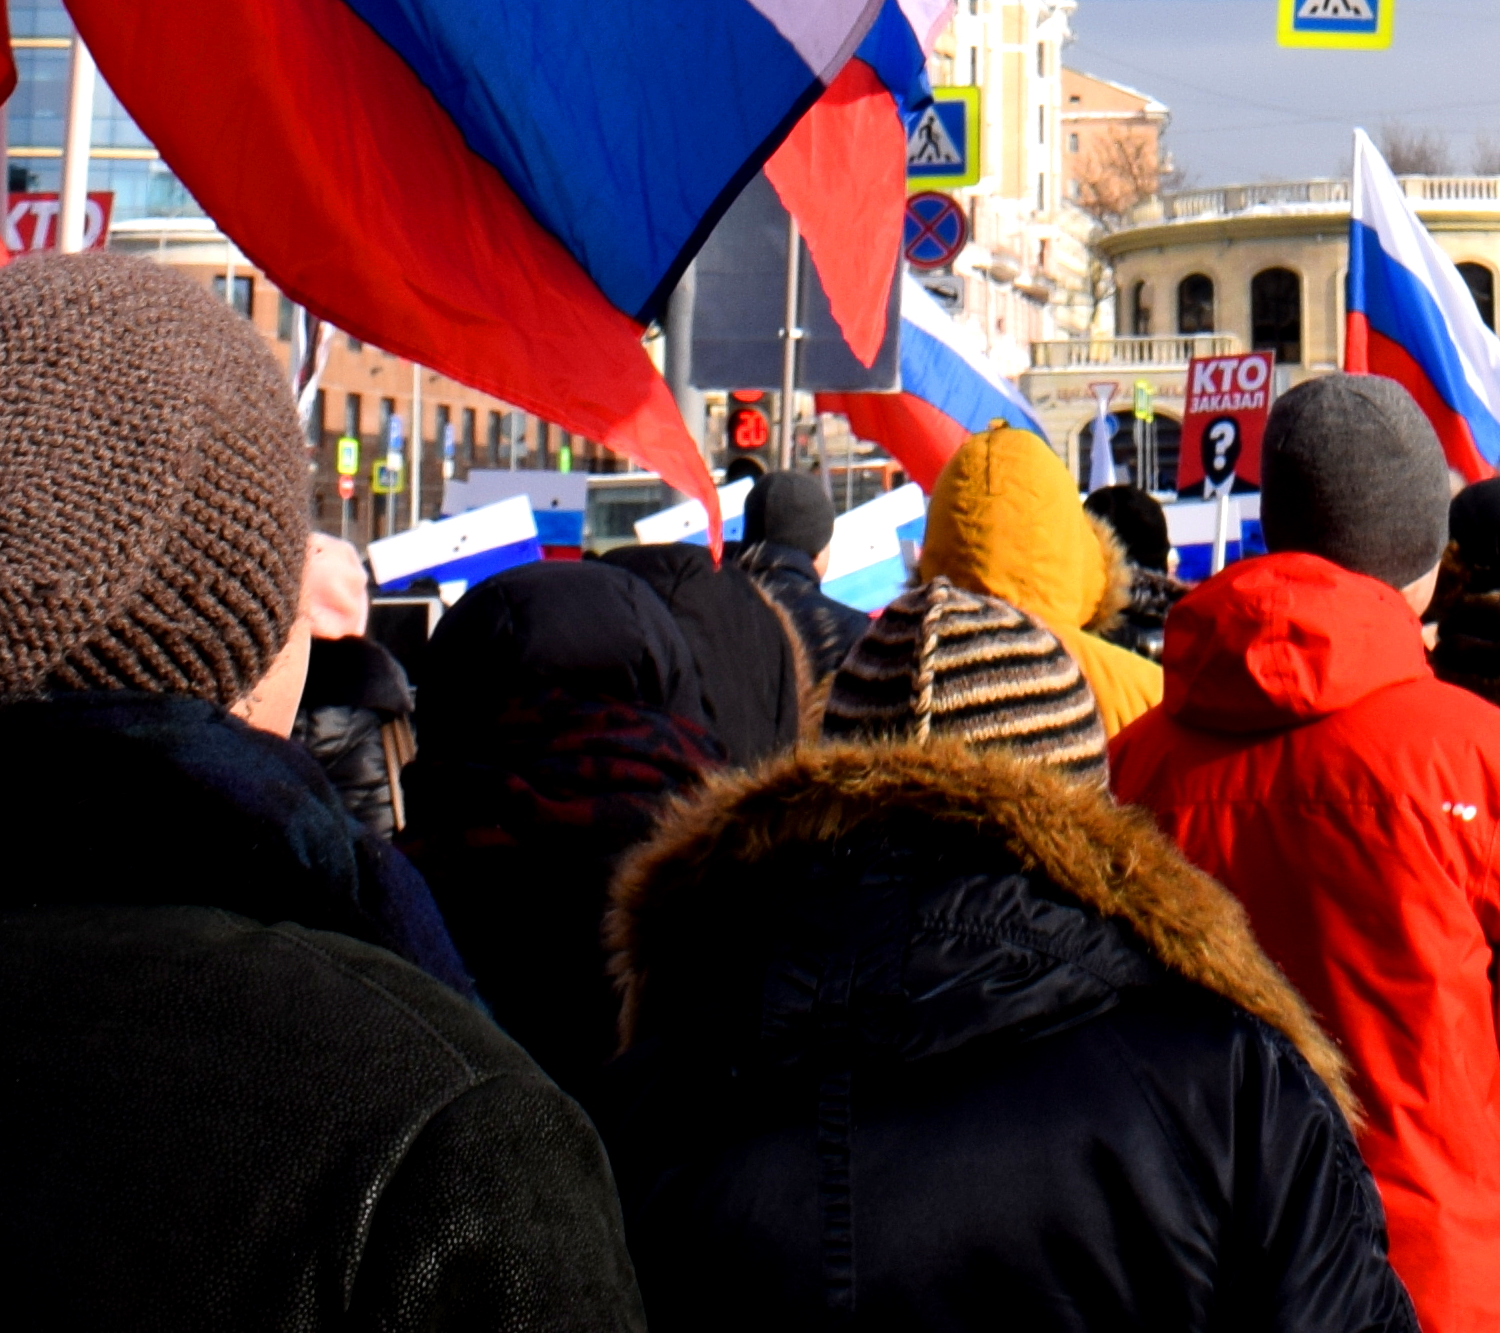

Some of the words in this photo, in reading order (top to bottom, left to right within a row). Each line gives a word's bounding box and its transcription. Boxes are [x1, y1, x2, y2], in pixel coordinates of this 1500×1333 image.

[1192, 355, 1268, 394] КТО
[1189, 391, 1265, 413] ЗАКАЗАЛ
[735, 410, 769, 448] 20
